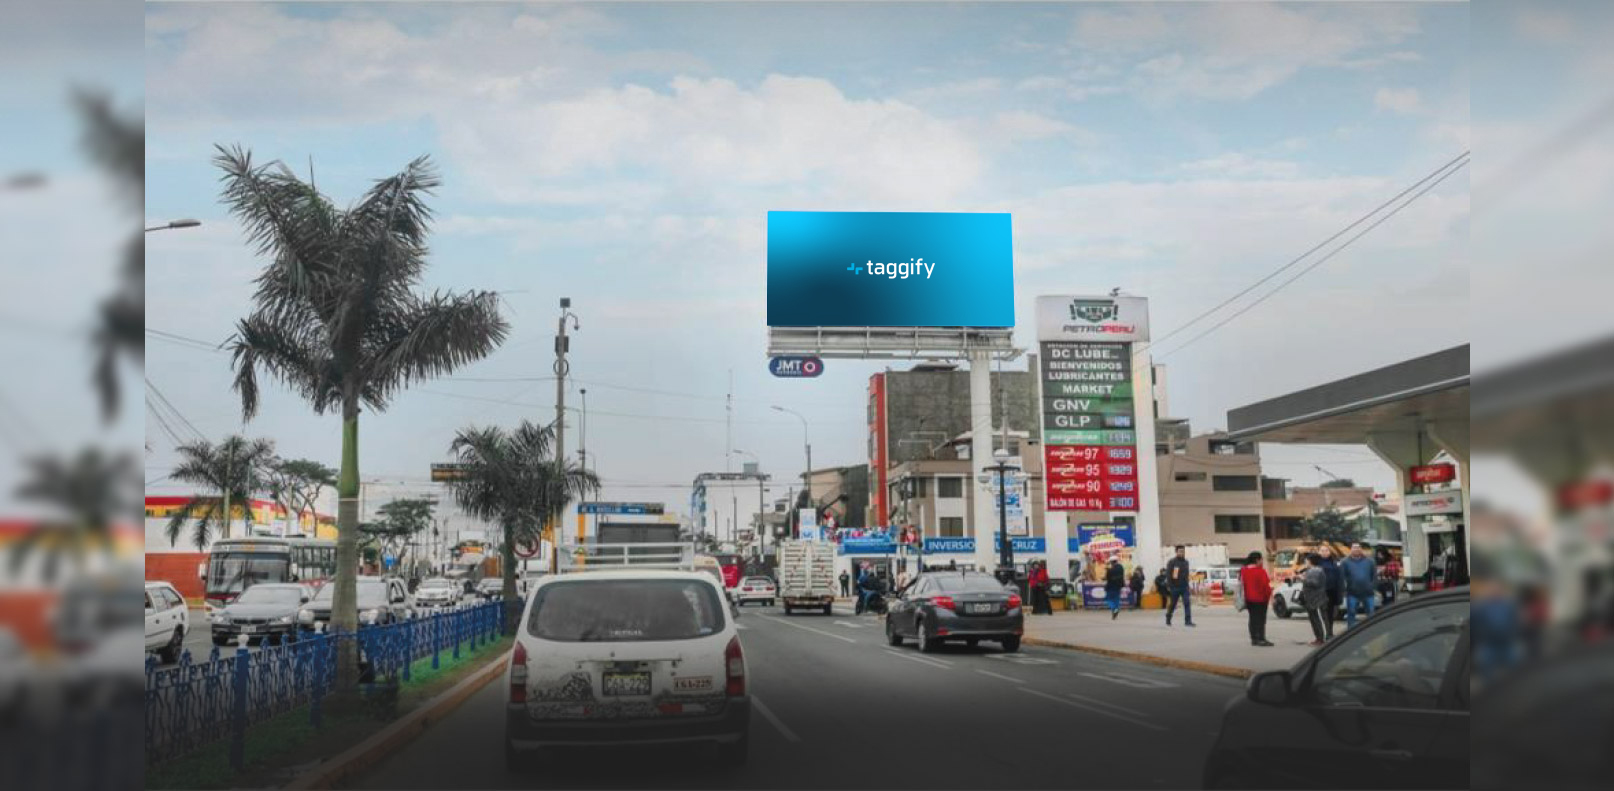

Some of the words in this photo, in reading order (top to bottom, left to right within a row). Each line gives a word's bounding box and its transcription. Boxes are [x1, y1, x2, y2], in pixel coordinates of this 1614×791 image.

[866, 258, 936, 279] taggify
[1051, 349, 1071, 358] DC
[1074, 349, 1110, 358] LUBE
[777, 360, 802, 371] JMT
[1049, 361, 1123, 370] BIENVENIDOS
[1048, 372, 1124, 380] LUBRICANTES
[1062, 385, 1113, 394] MARKET
[1053, 399, 1090, 411] GNV
[1055, 415, 1090, 427] GLP
[1084, 448, 1099, 460] 97
[1085, 464, 1100, 475] 95
[1086, 480, 1101, 492] 90
[928, 541, 976, 550] INVERSIO
